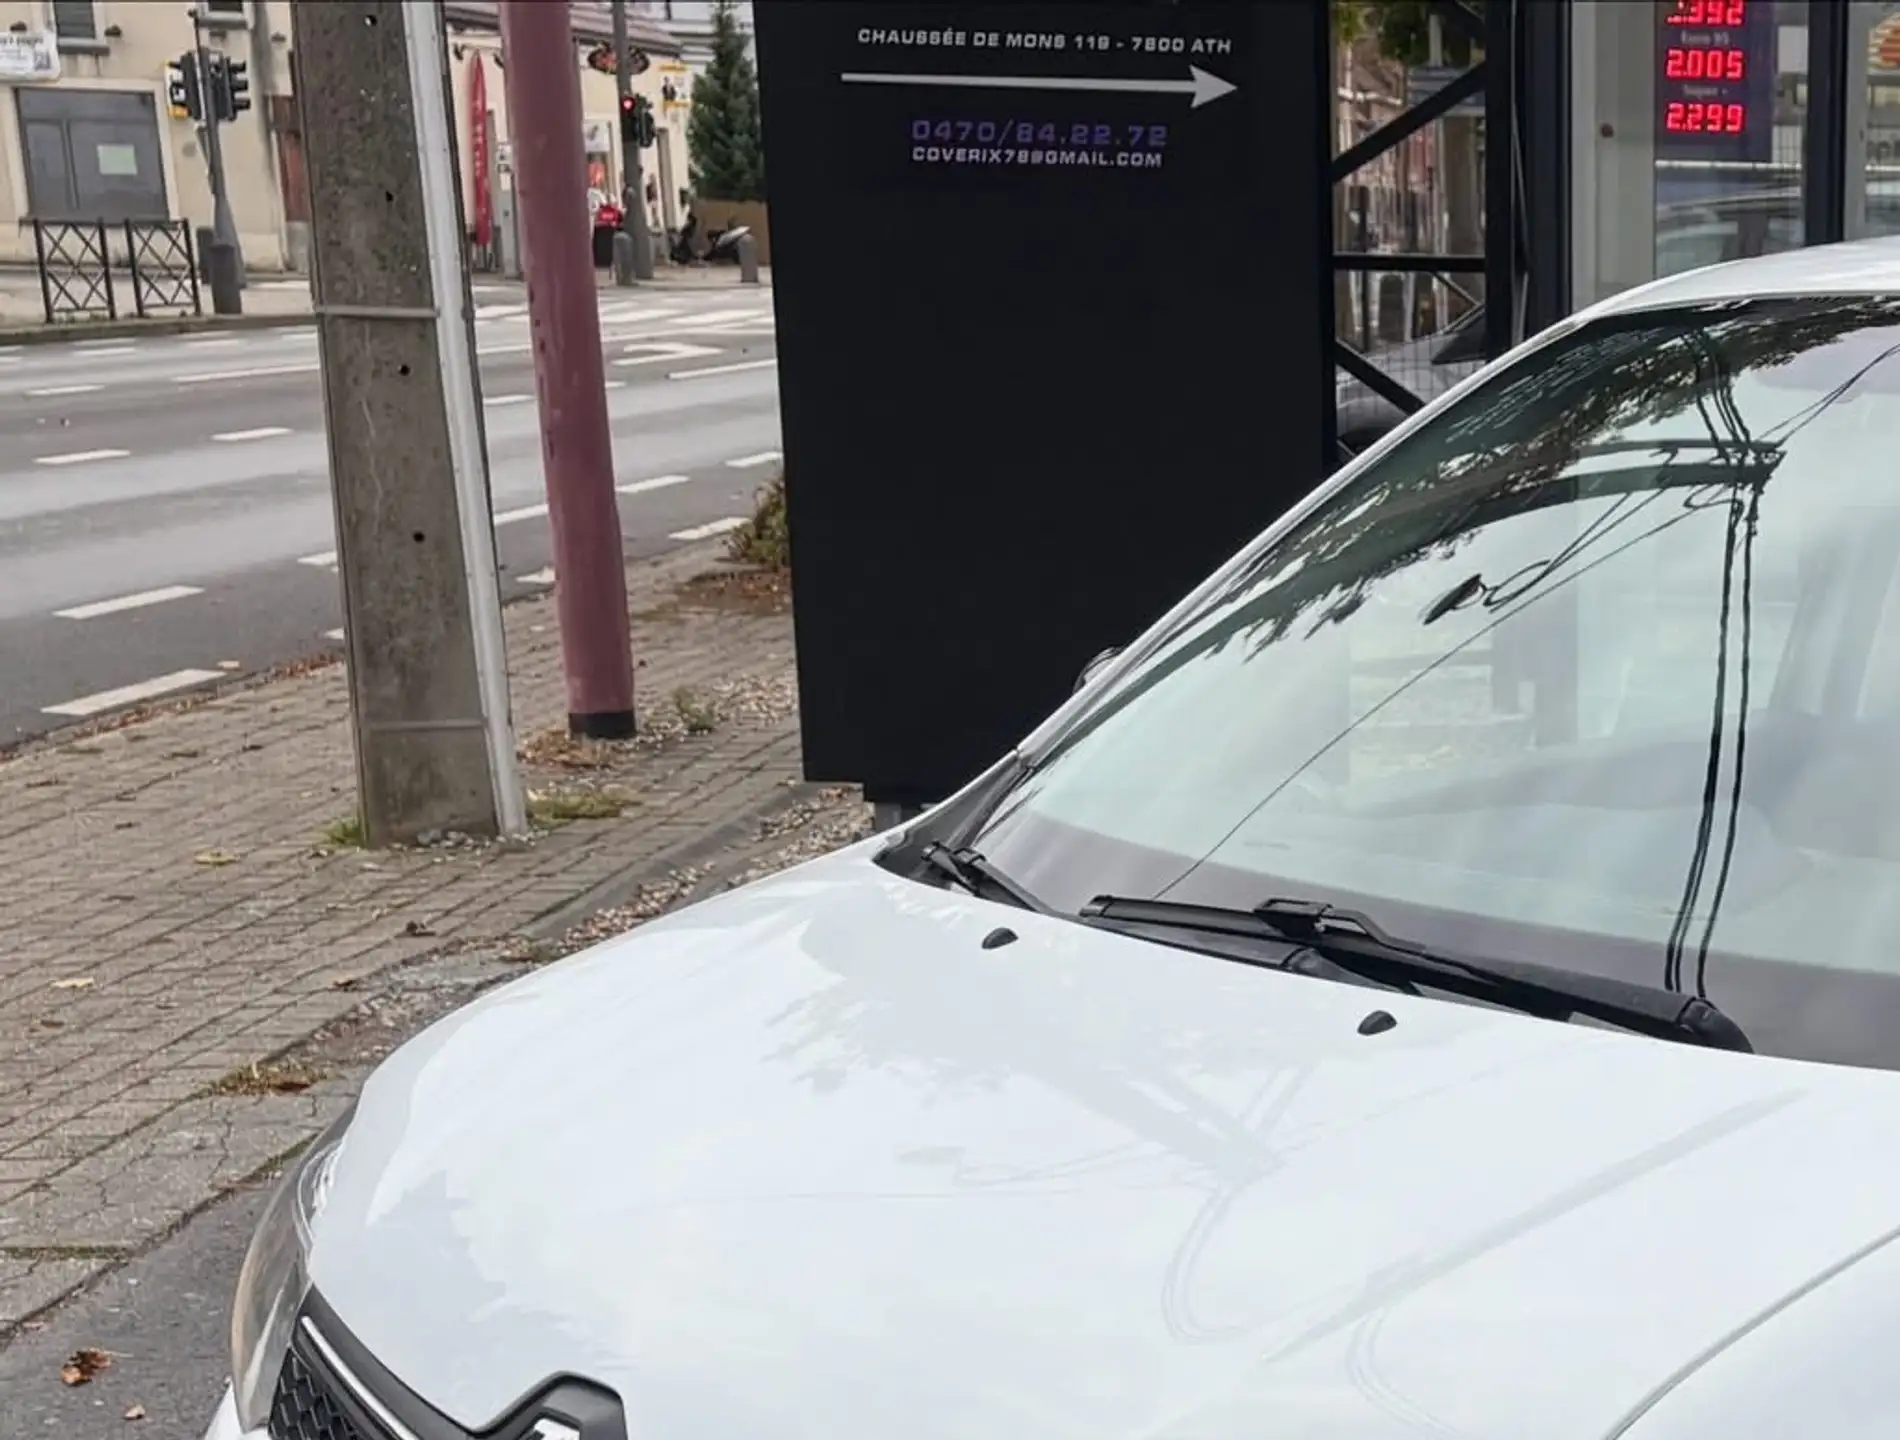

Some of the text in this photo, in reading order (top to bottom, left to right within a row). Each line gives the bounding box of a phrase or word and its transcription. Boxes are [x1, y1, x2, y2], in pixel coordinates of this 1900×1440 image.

[857, 26, 967, 46] CHAUSSÉE
[973, 32, 1000, 46] DE
[1006, 33, 1066, 48] MONS
[1131, 36, 1185, 52] 7800
[1191, 38, 1232, 53] ATH
[1667, 49, 1743, 78] 2.005
[1667, 103, 1743, 132] 2.299
